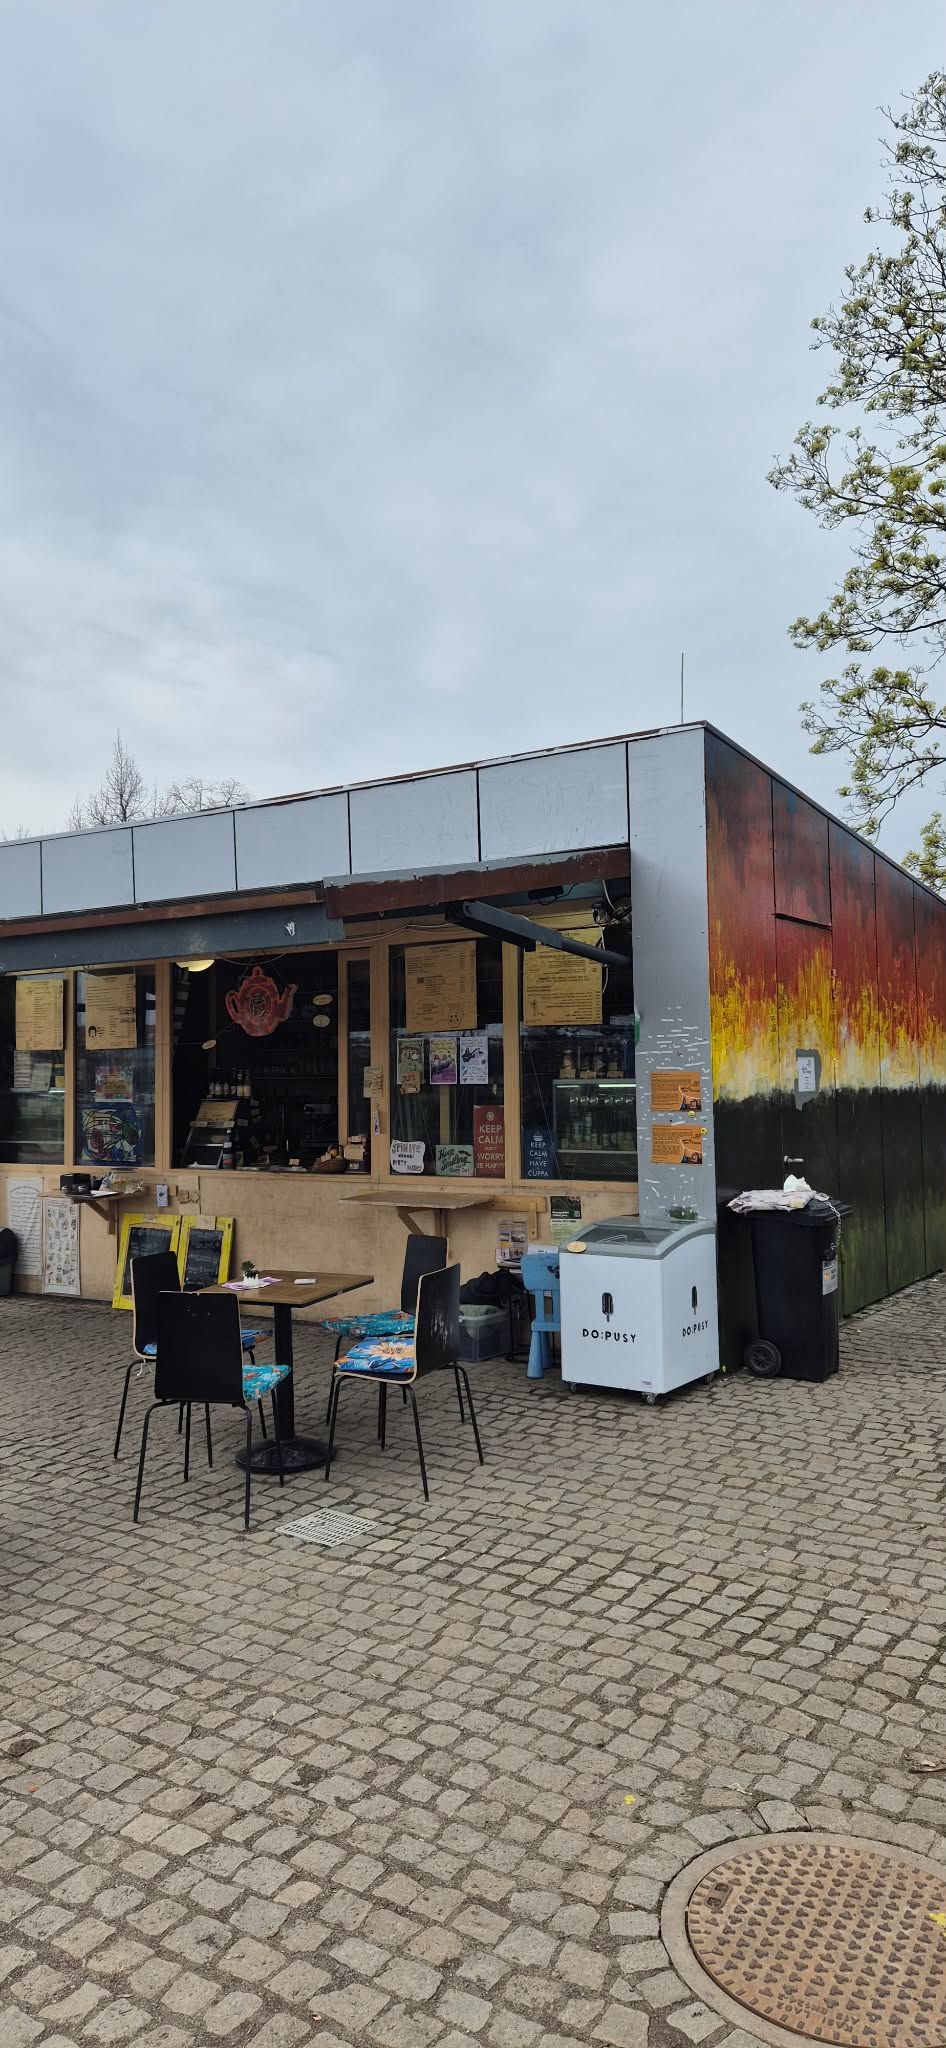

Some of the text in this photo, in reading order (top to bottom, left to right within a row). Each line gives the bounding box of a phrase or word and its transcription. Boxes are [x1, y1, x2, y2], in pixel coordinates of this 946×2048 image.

[479, 1124, 502, 1133] KEEP
[478, 1135, 504, 1144] CALM
[582, 1328, 636, 1343] DO:PUSY
[682, 1320, 709, 1338] DO:PUSY
[821, 2015, 854, 2033] KASI
